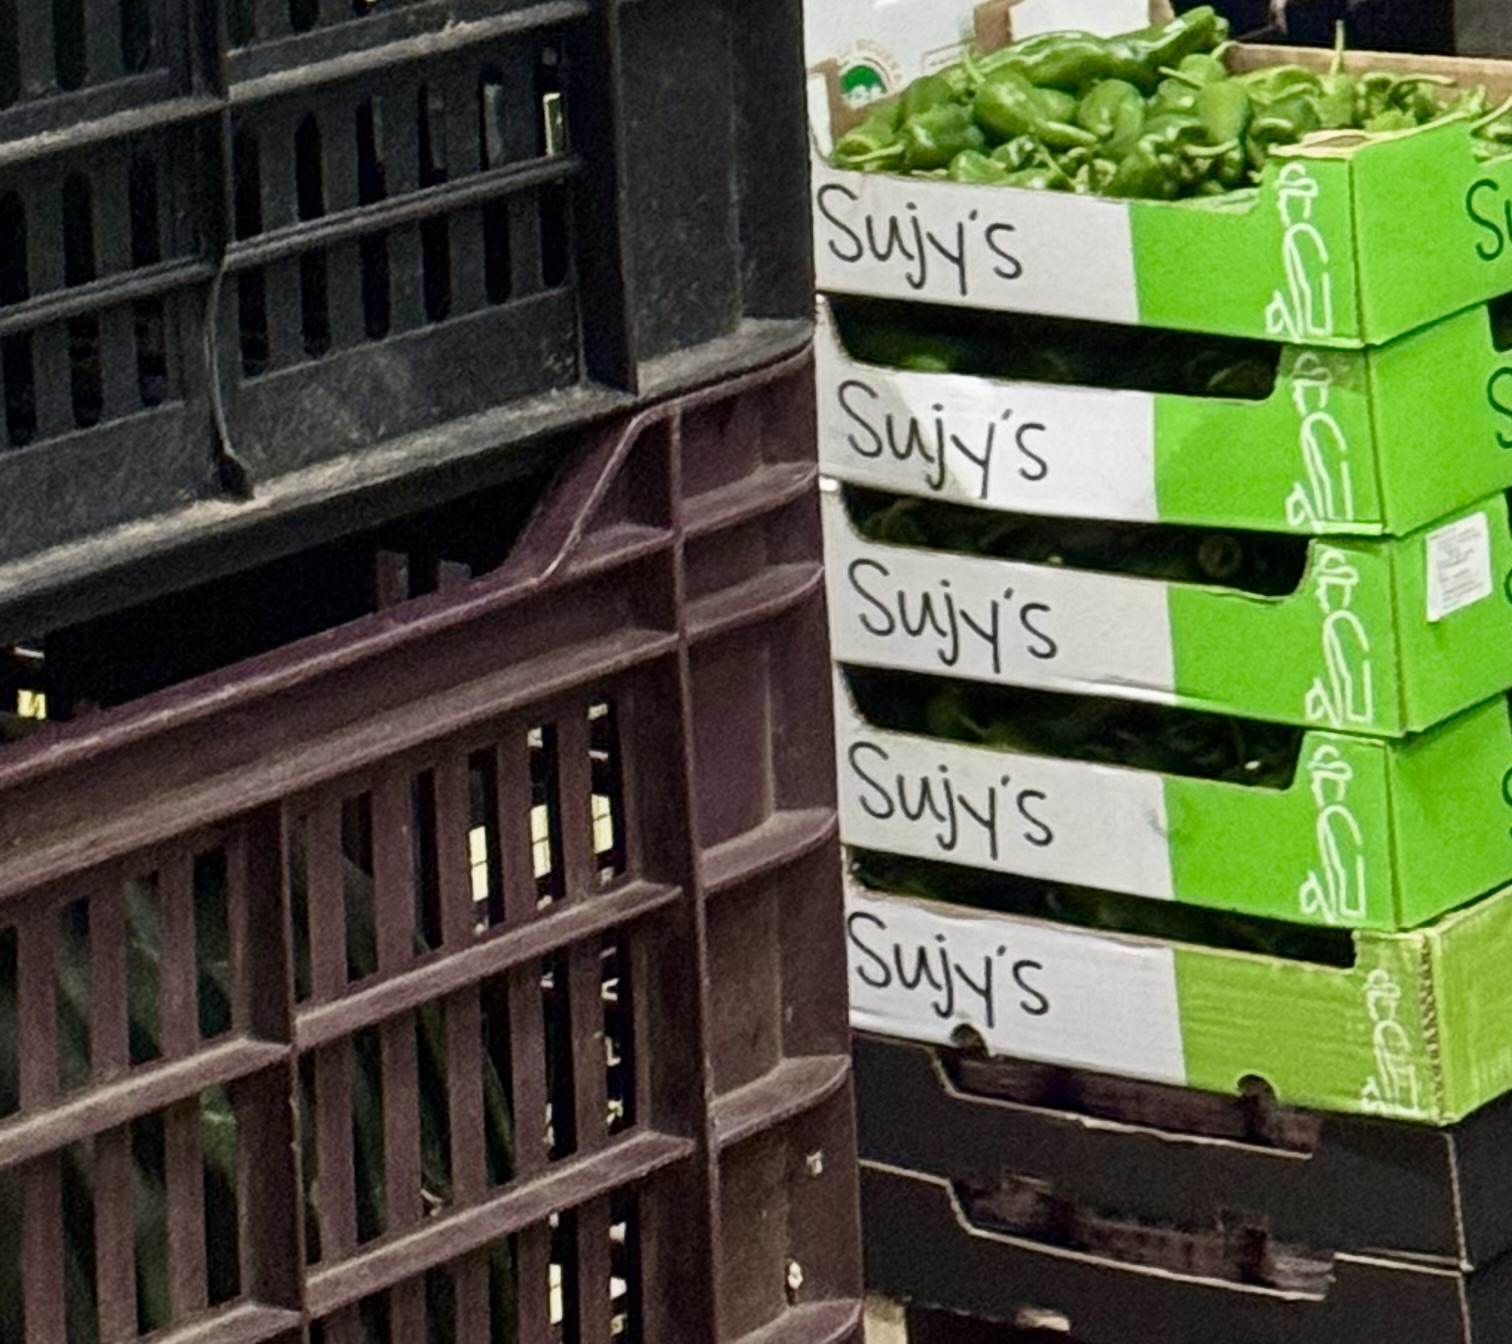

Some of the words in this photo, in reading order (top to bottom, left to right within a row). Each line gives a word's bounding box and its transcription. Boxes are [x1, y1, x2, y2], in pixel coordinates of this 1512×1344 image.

[816, 183, 1025, 297] Sujy's
[836, 380, 1050, 499] Sujy's
[846, 558, 1059, 674] Sujy's
[846, 740, 1056, 854] Sujy's
[846, 910, 1052, 1028] Sujy's
